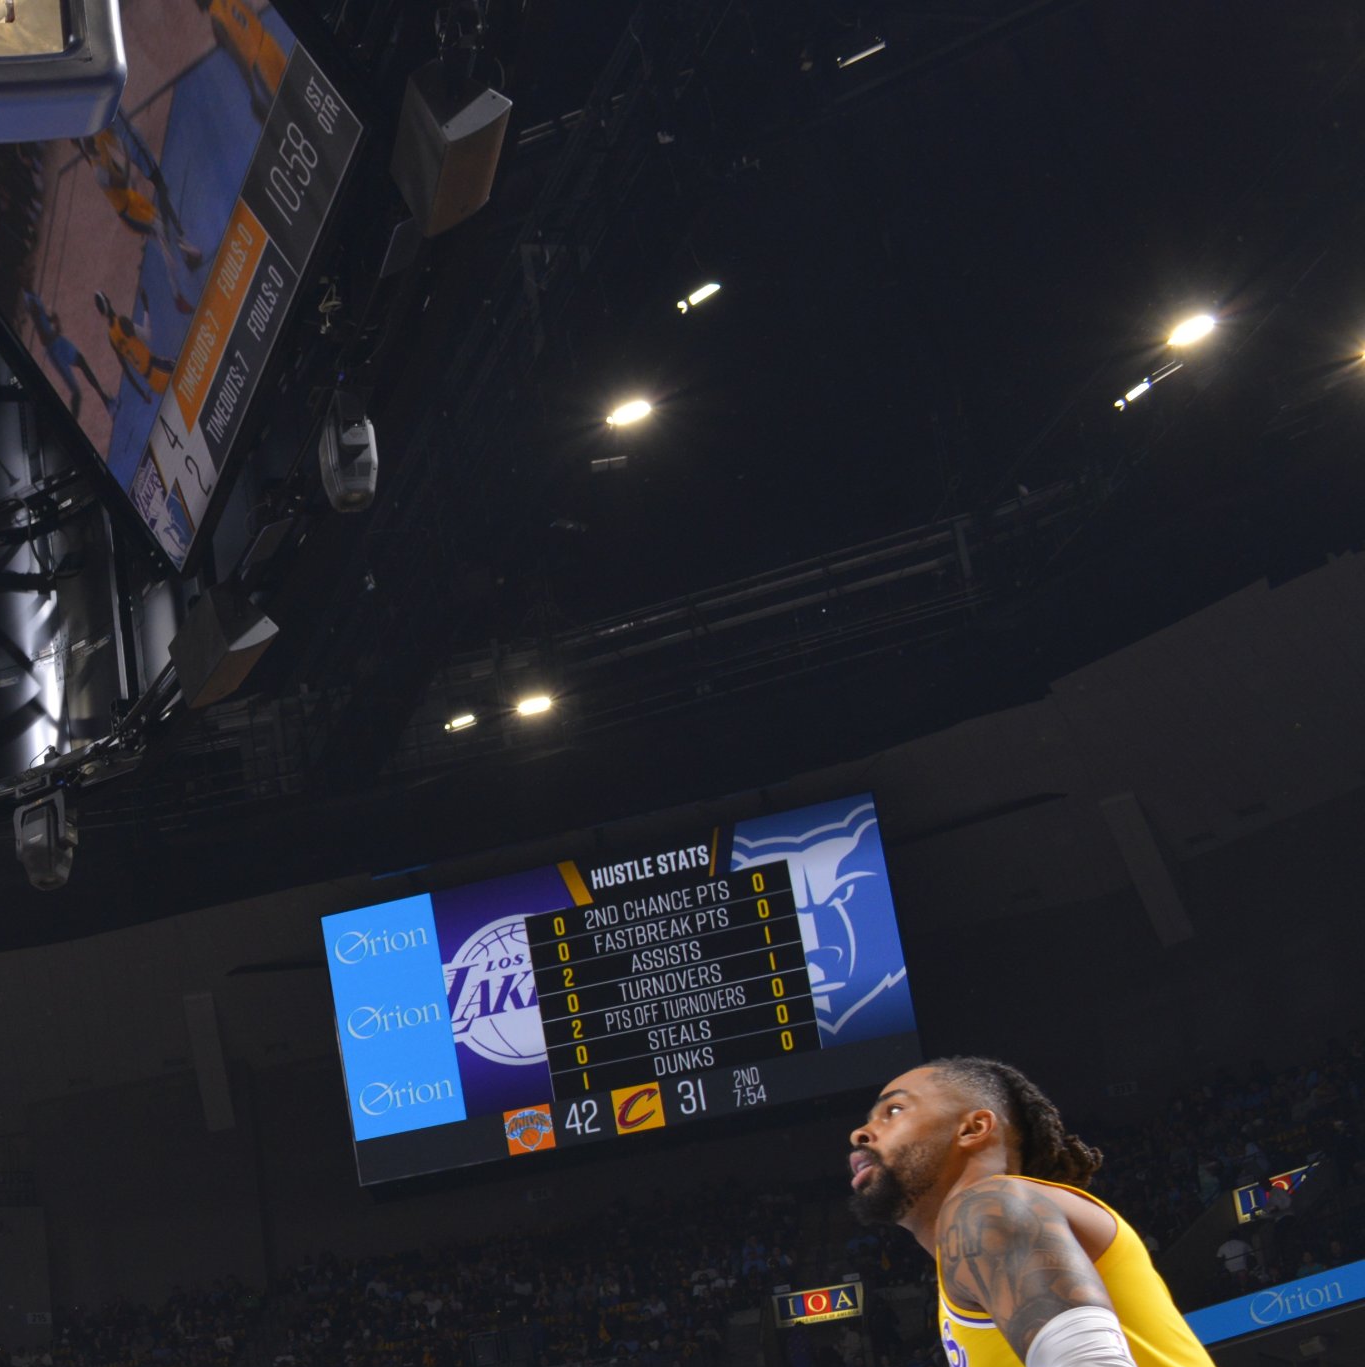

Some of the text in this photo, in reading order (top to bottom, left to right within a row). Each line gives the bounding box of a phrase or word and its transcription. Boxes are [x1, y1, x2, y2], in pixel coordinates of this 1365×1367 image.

[265, 122, 318, 226] 10:58
[159, 414, 184, 450] 4
[185, 454, 212, 497] 2
[590, 844, 710, 890] HUSTLE STATS
[553, 872, 765, 936] 0 2ND CHANCE PTS 0
[334, 926, 428, 965] Orion
[558, 899, 770, 962] 0 FASTBREAK PTS 0
[485, 953, 525, 972] LOS
[563, 940, 702, 988] 2 ASSISTS
[567, 963, 723, 1013] 0 TURNOVERS
[572, 977, 784, 1039] 2 PTS OFF TURNOVERS 0
[347, 1002, 441, 1040] Orion
[576, 1004, 789, 1065] 0 STEALS 0
[653, 1030, 794, 1077] DUNKS 0
[359, 1079, 454, 1116] Orion
[732, 1085, 767, 1107] 7:54
[733, 1066, 760, 1089] 2ND
[565, 1078, 707, 1135] 42 31
[1249, 1278, 1344, 1326] Orion
